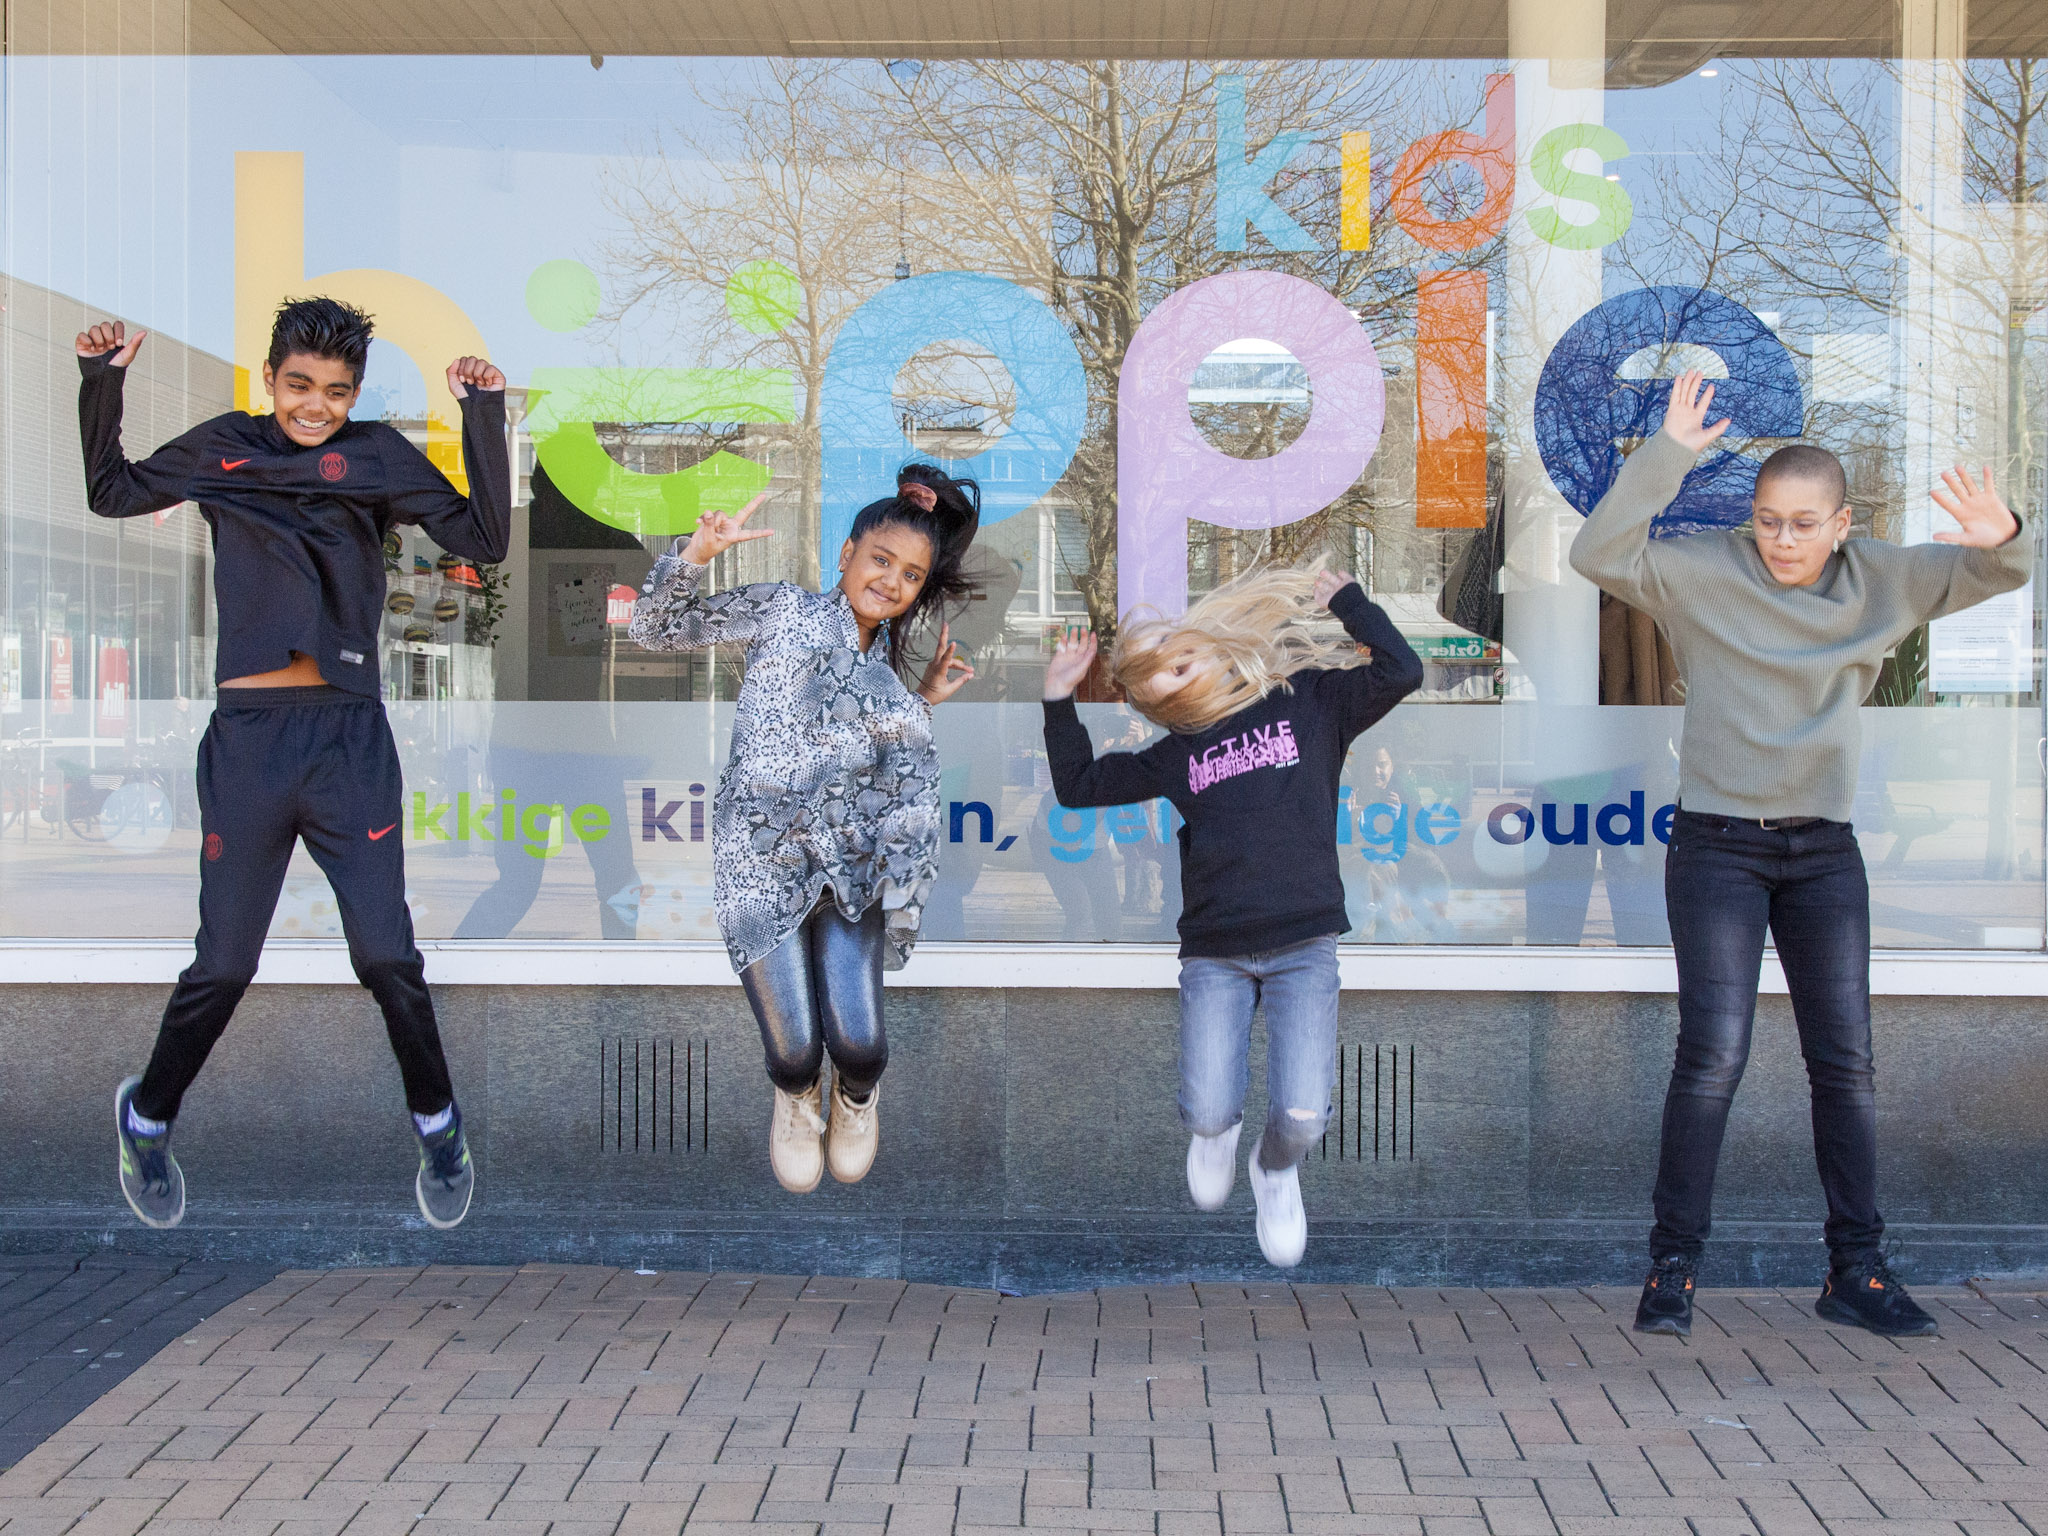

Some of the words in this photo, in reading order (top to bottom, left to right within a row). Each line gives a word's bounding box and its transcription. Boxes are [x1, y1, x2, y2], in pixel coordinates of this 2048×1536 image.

[1216, 74, 1633, 251] kids
[402, 788, 611, 859] kkige
[1048, 785, 1462, 864] gelige
[1487, 790, 1677, 846] oude
